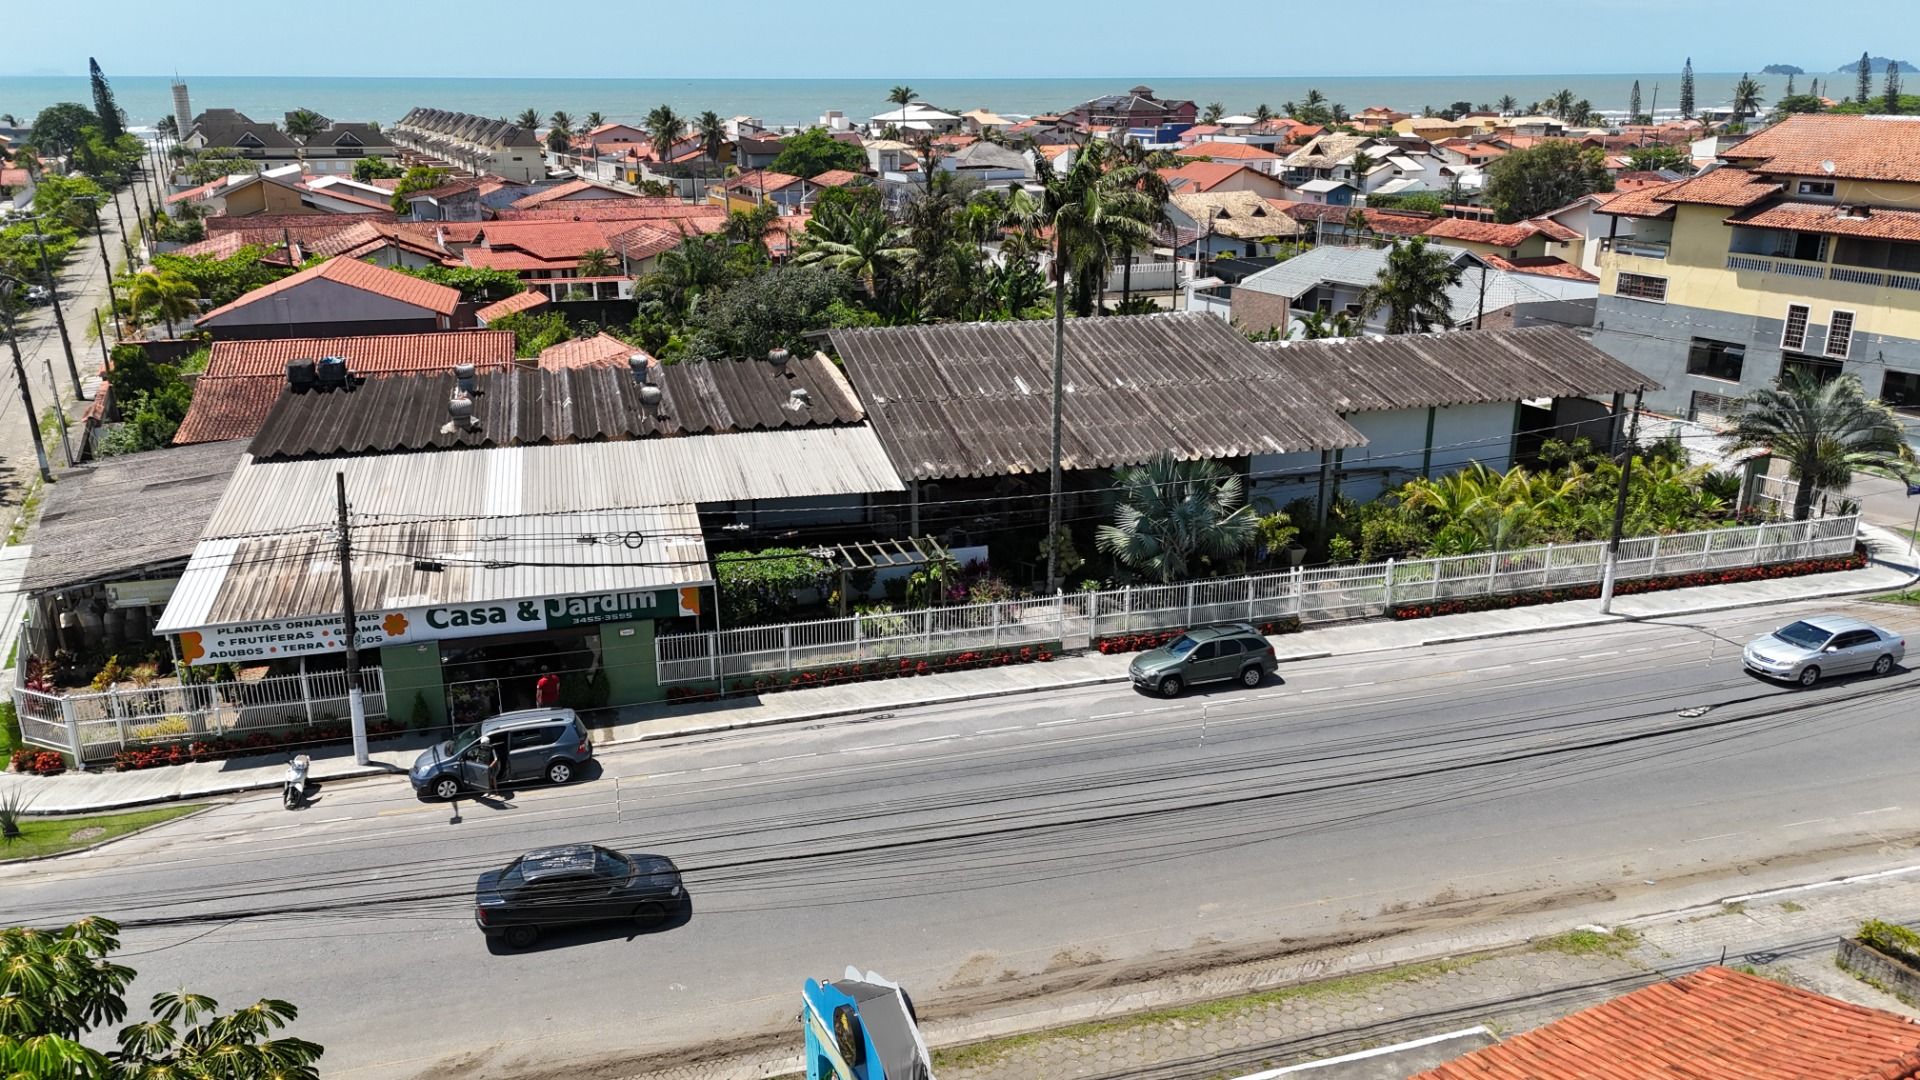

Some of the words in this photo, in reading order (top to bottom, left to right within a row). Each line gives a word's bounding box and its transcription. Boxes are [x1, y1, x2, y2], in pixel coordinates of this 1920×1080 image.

[425, 606, 507, 629] Casa
[517, 600, 542, 622] &
[549, 591, 657, 617] Jardim
[217, 623, 281, 635] PLANTAS
[285, 613, 380, 630] ORNAMETAIS
[209, 647, 264, 659] ADUBOS
[281, 641, 325, 653] TERRA
[338, 635, 383, 647] VSOS
[229, 631, 314, 646] FRUTÍFERAS
